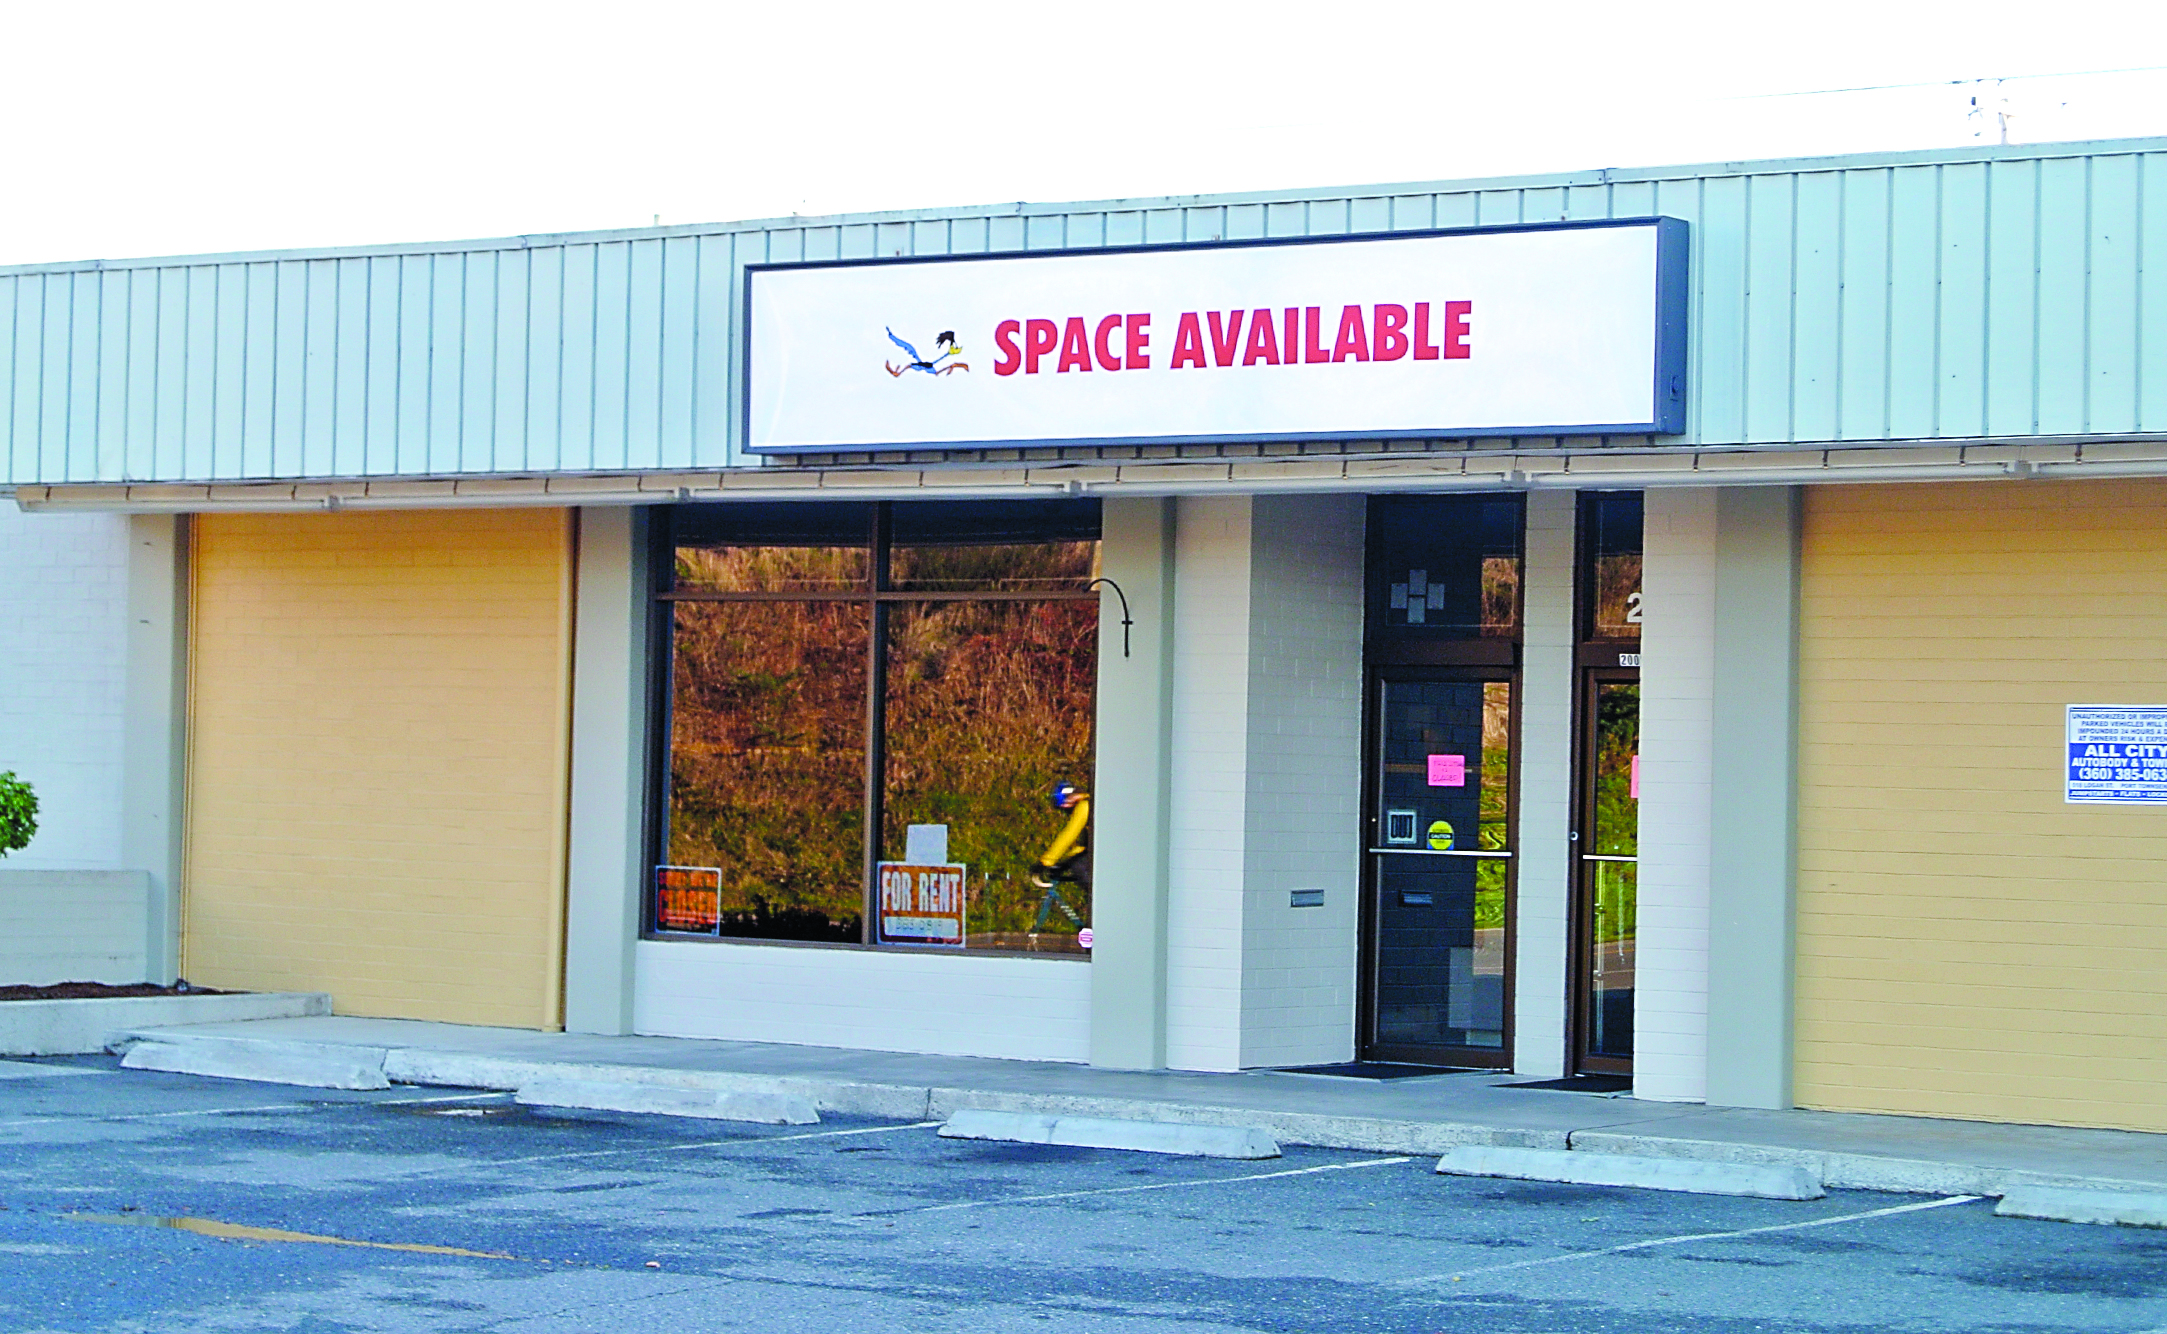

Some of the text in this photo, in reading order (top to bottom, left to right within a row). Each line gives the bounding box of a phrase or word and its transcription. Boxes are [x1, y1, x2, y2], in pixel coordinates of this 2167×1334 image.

[994, 300, 1472, 376] SPACE AVAILABLE
[2085, 745, 2167, 758] ALL CITY
[2072, 758, 2128, 767] AUTOBODY
[2131, 759, 2139, 768] &
[2080, 768, 2113, 780] (360)
[882, 871, 960, 913] FOR RENT
